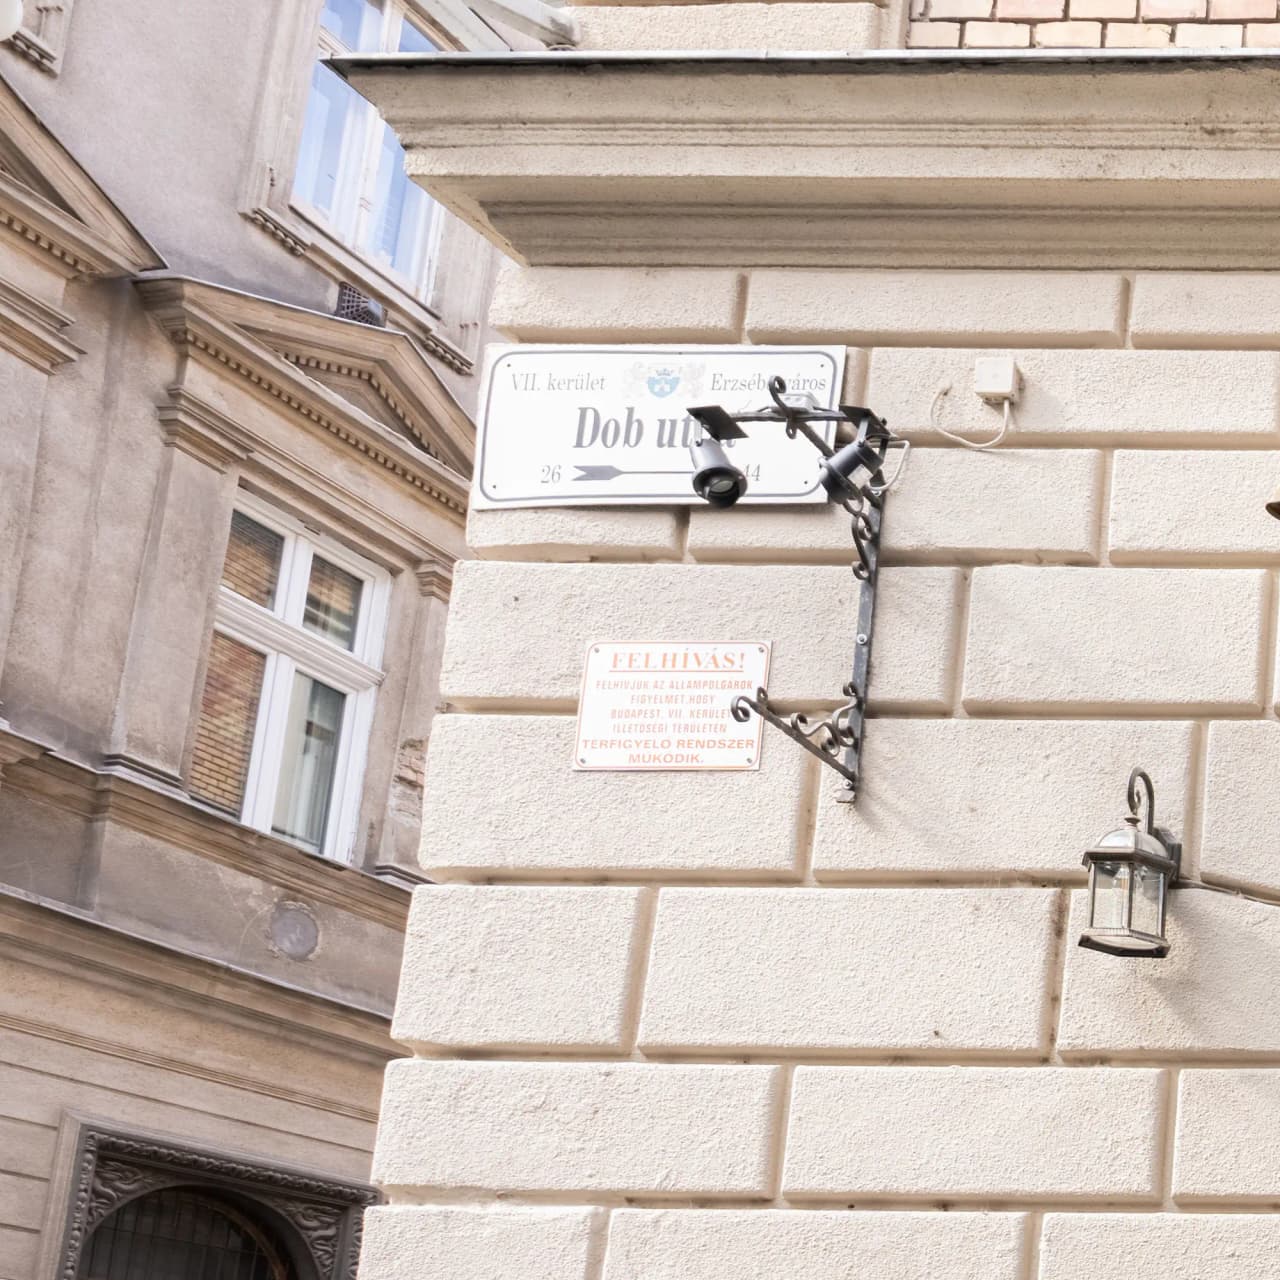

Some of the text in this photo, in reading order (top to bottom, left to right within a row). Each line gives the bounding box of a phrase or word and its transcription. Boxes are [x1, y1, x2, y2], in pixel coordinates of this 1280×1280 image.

[512, 372, 827, 391] VII. kerület Erzsébváros
[572, 406, 644, 449] Dob
[540, 464, 562, 483] 26
[611, 648, 745, 669] FELHÍVÁS!
[676, 738, 755, 750] RENDSZER
